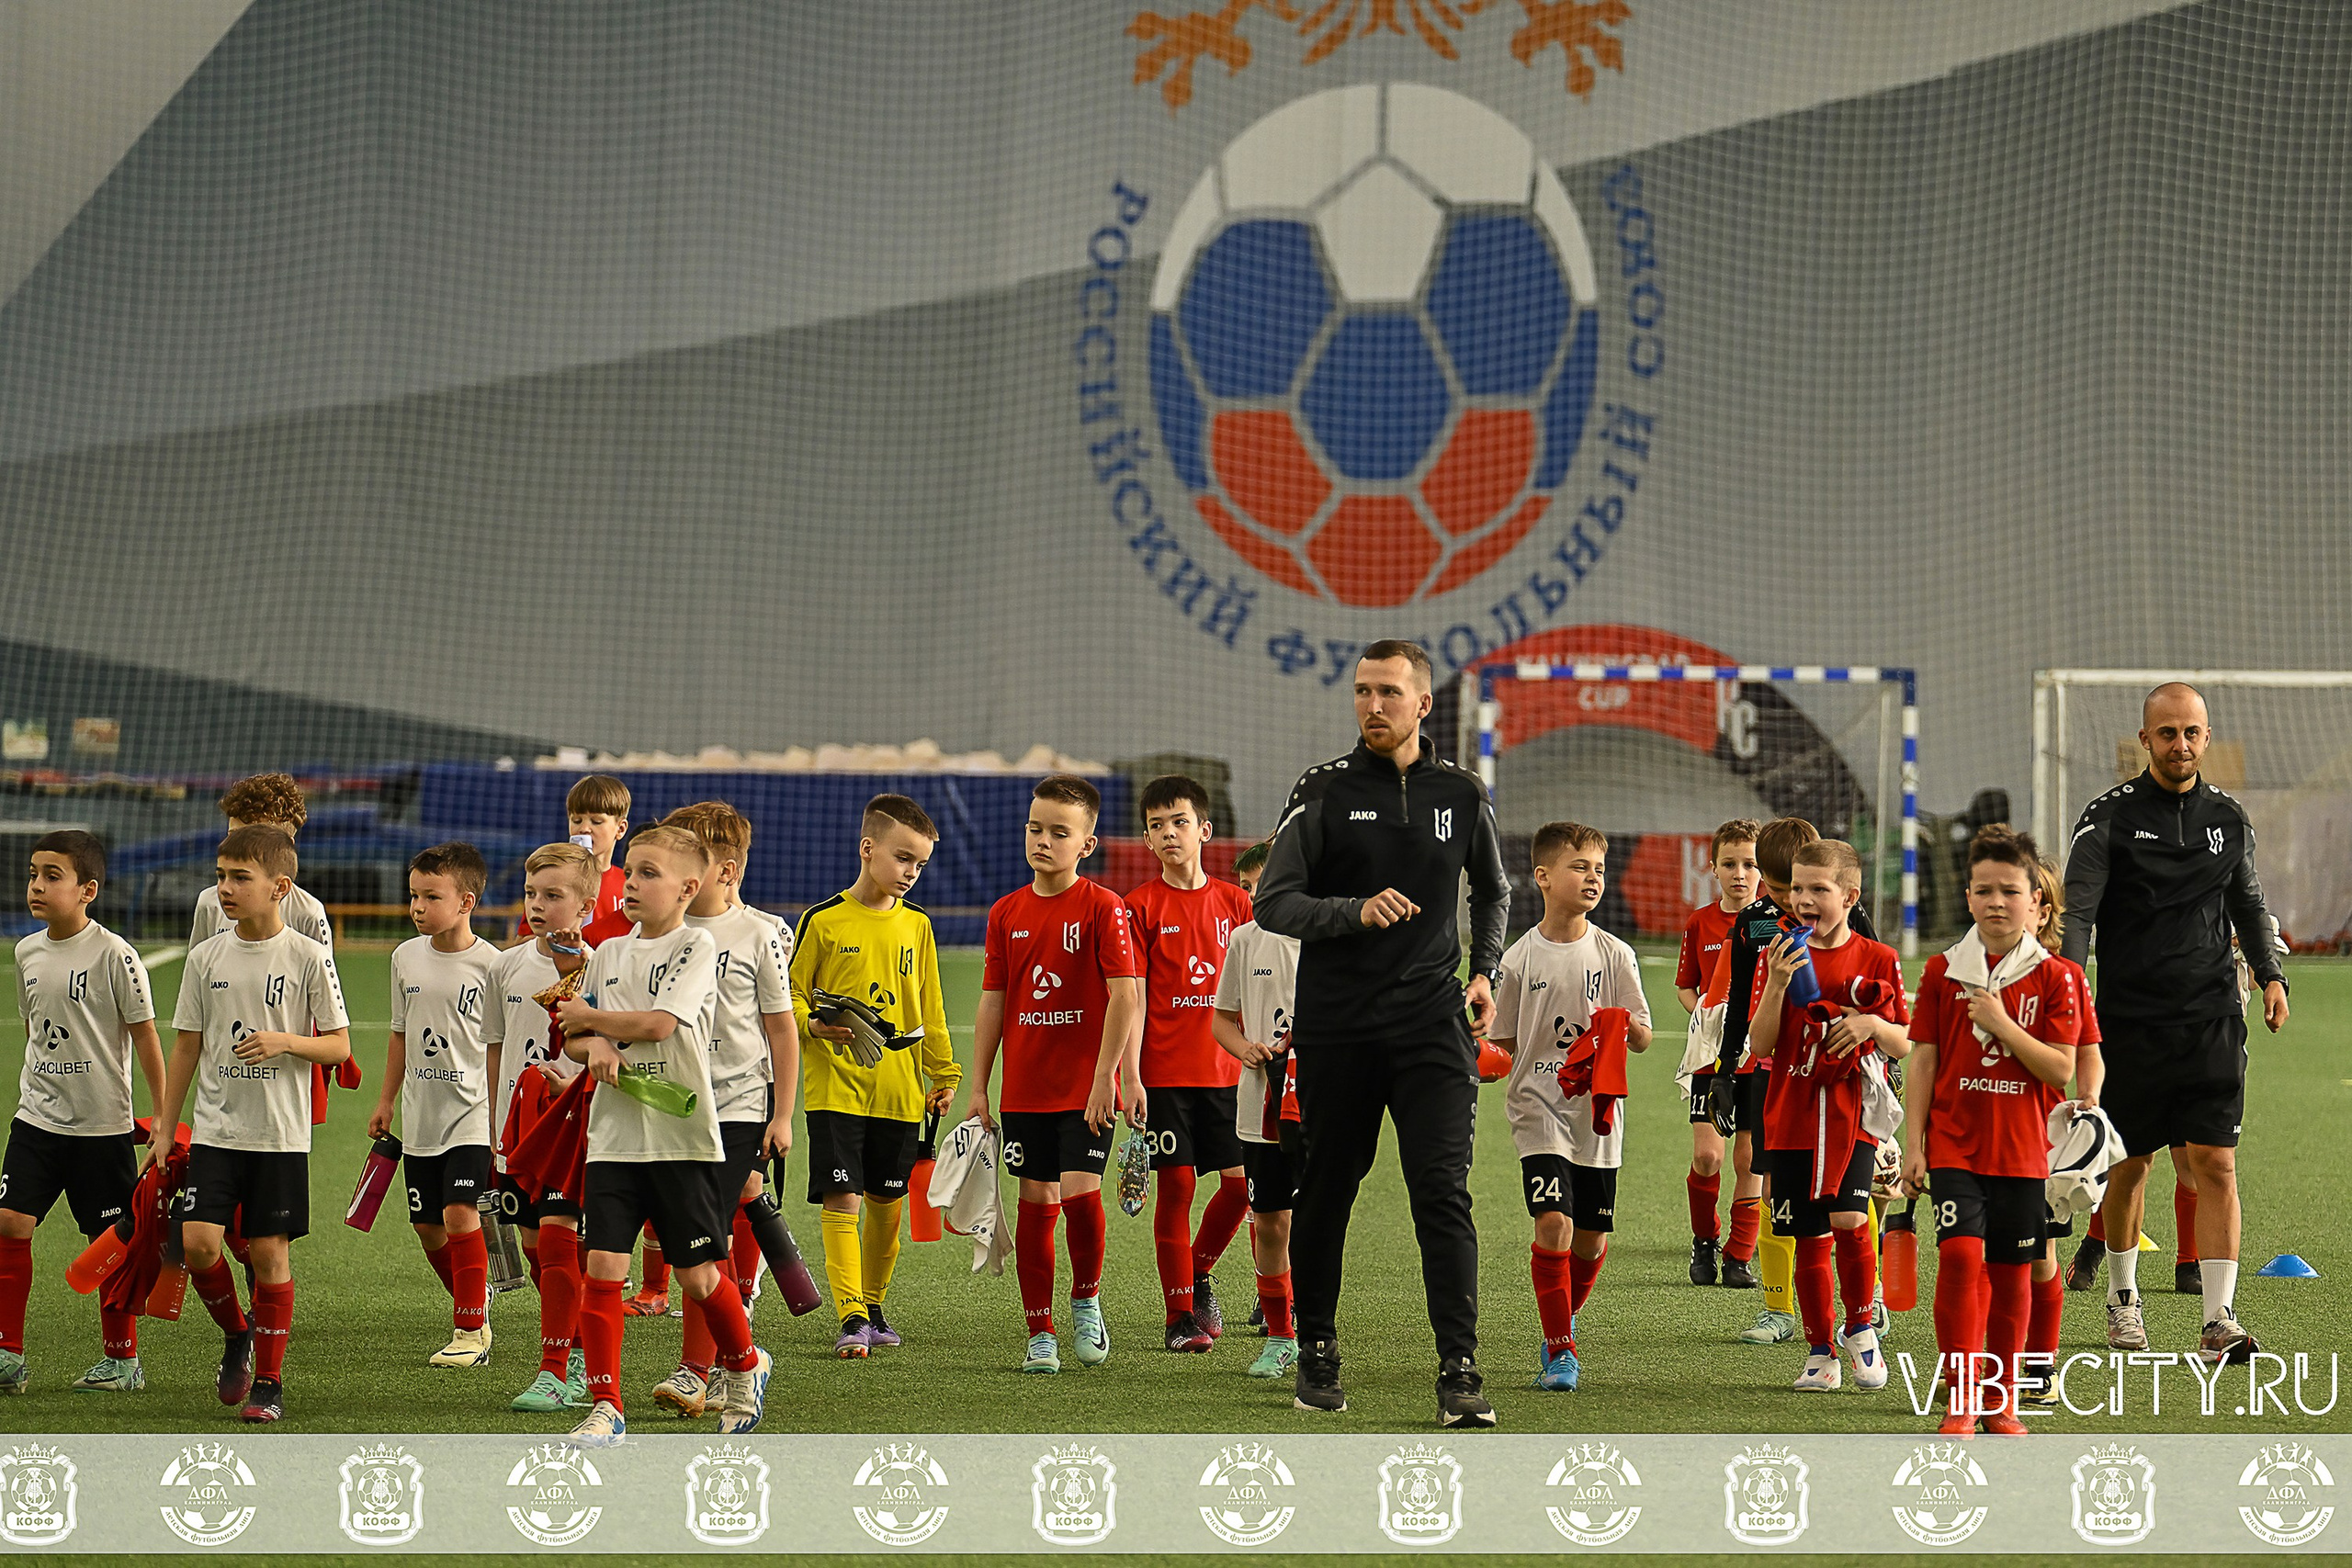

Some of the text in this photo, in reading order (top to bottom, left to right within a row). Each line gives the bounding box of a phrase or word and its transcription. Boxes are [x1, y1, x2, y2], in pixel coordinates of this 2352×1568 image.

[1074, 179, 1257, 645] РОССИЙСКИЙ
[1267, 401, 1653, 687] ФУОЛЬНЫЙ
[1577, 685, 1631, 710] CUP
[1349, 810, 1377, 820] JAKO
[1012, 931, 1029, 940] JAKO
[1160, 925, 1180, 935] JAKO
[839, 946, 860, 954] JAKO
[1704, 943, 1722, 952] JAKO
[1253, 968, 1272, 976] JAKO
[210, 980, 229, 989] JAKO
[1018, 1010, 1084, 1026] РАСЦВЕТ
[218, 1065, 280, 1080] РАСЦВЕТ
[1959, 1077, 2027, 1095] РАСЦВЕТ
[1690, 1093, 1706, 1116] 11
[1147, 1130, 1177, 1156] 30
[1002, 1140, 1024, 1167] 69
[1087, 1148, 1105, 1159] JAKO
[978, 1150, 994, 1171] JAKO
[833, 1168, 849, 1182] 96
[454, 1179, 475, 1188] JAKO
[884, 1179, 904, 1189] JAKO
[1531, 1176, 1563, 1203] 24
[547, 1191, 566, 1201] JAK
[100, 1206, 122, 1219] JAKO
[689, 1235, 711, 1249] JAKO
[738, 1278, 752, 1287] KO
[455, 1305, 483, 1316] JAKO
[1023, 1306, 1051, 1318] JAKO
[541, 1337, 571, 1348] JAKO
[589, 1372, 613, 1386] AKO
